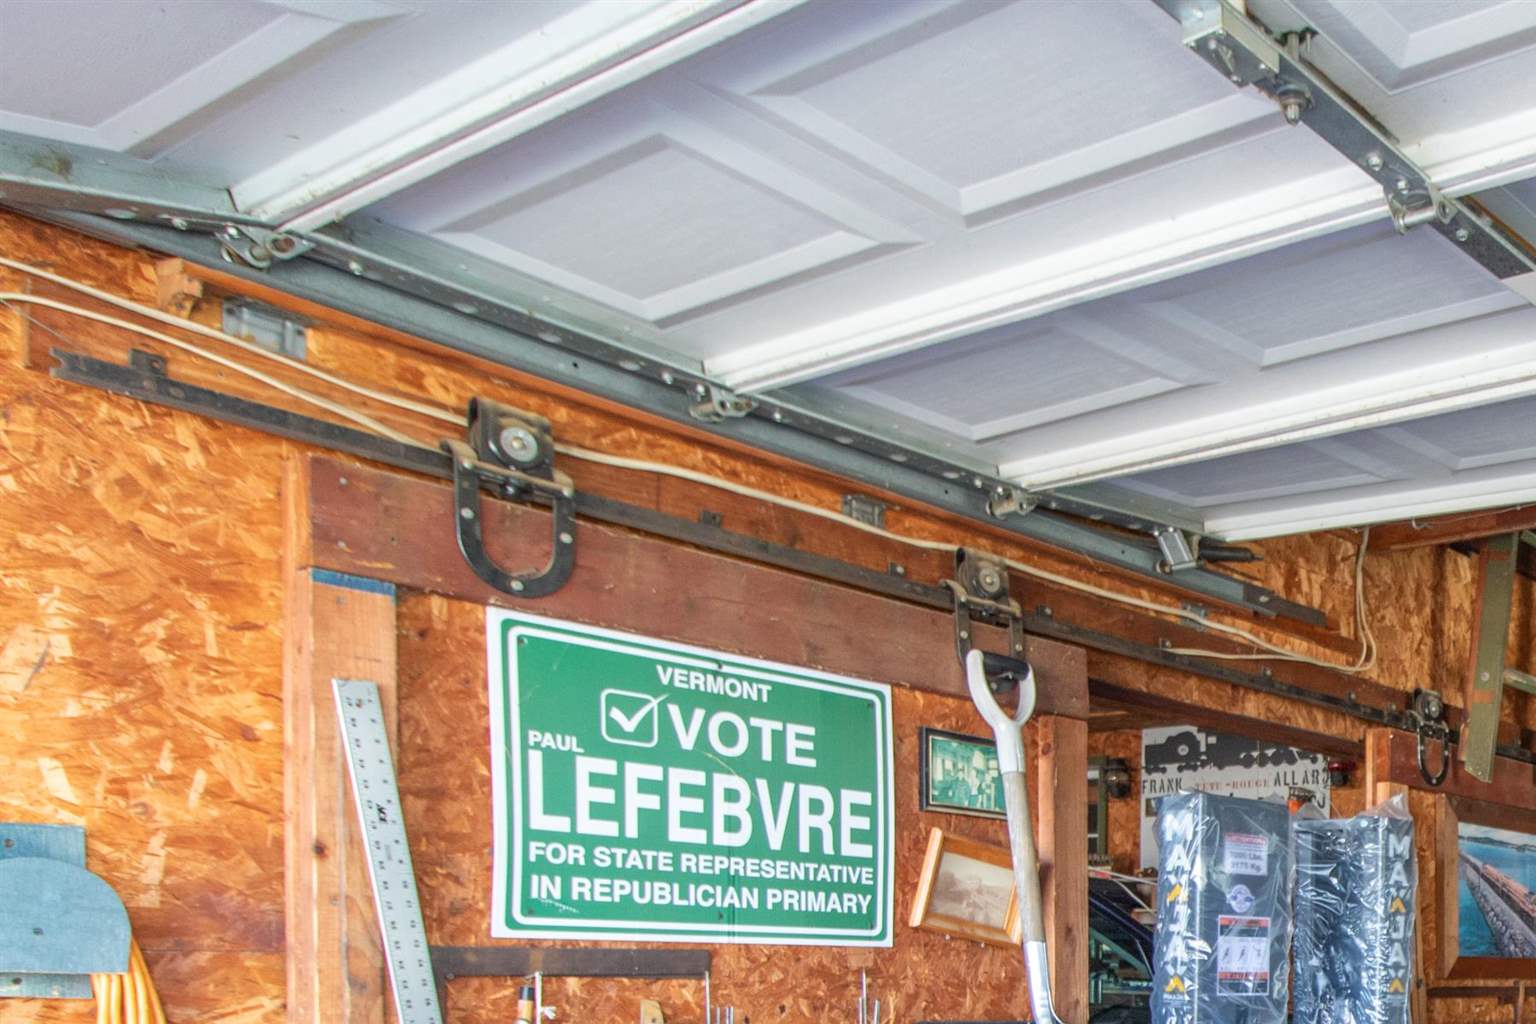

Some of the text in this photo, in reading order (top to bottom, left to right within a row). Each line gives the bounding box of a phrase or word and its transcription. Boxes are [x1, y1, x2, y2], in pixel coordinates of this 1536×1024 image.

[656, 665, 772, 702] VERMONT
[528, 731, 584, 753] PAUL
[667, 703, 817, 768] VOTE
[528, 750, 874, 858] LEFEBVRE
[1142, 778, 1182, 793] FRANK
[529, 841, 874, 886] FOR STATE REPRESENTATIVE
[531, 874, 873, 914] IN REPUBLICIAN PRIMARY
